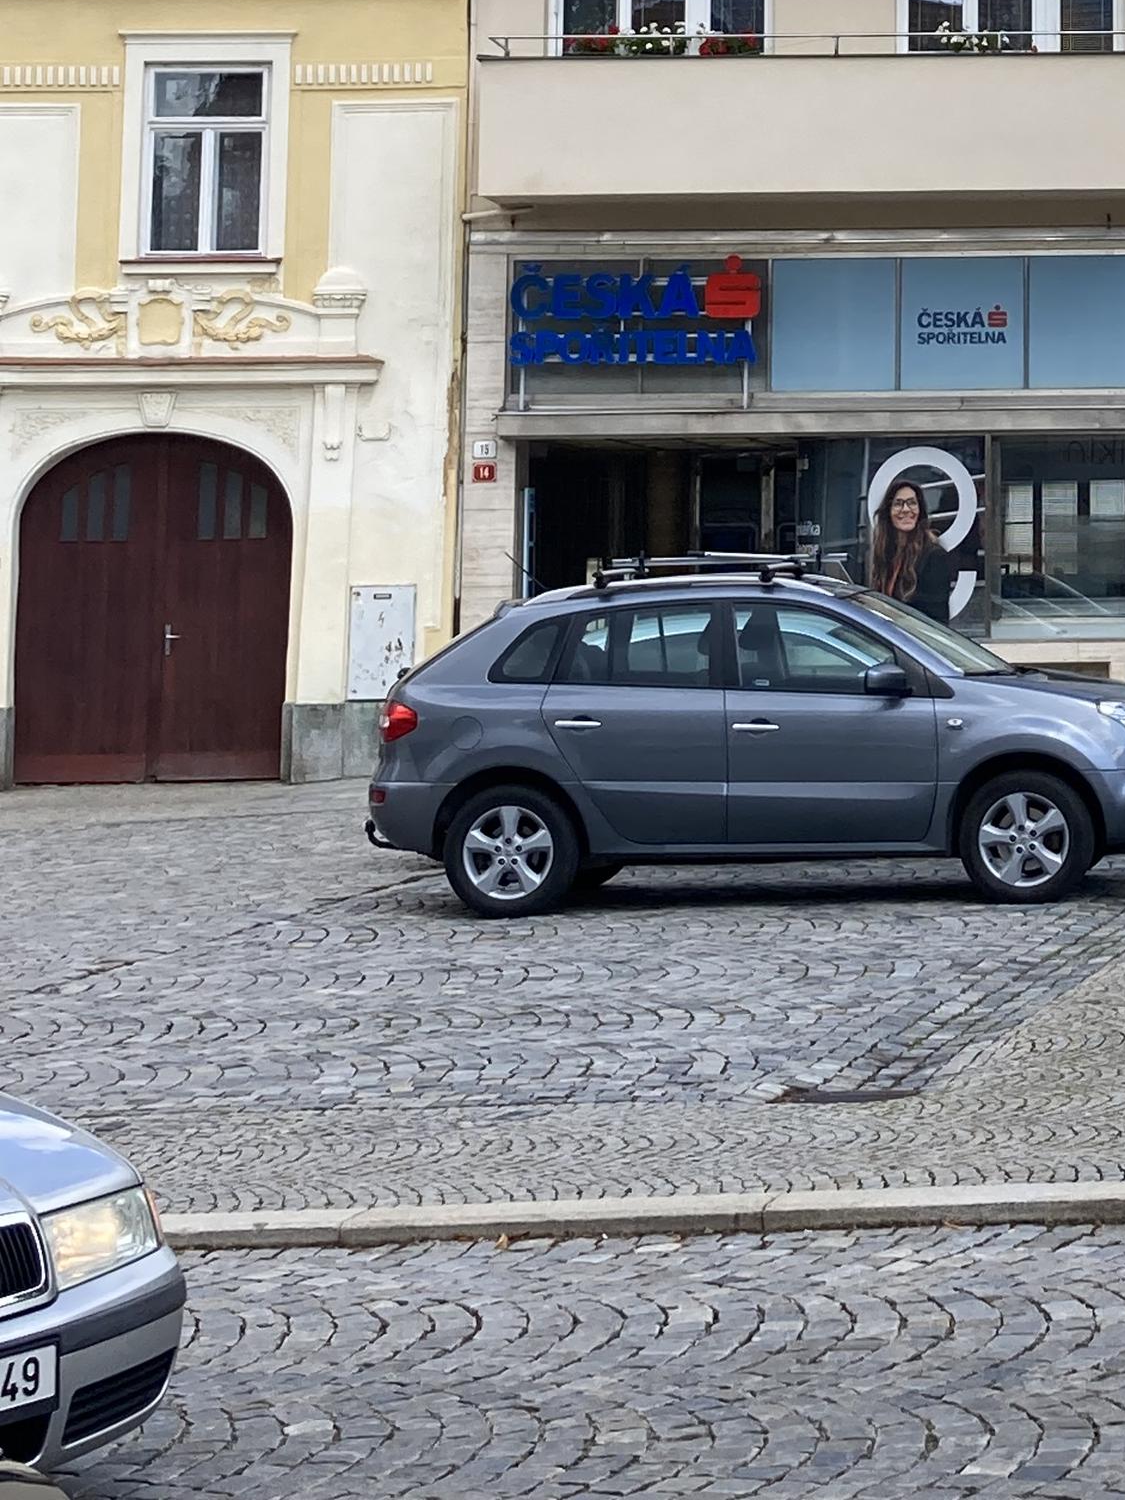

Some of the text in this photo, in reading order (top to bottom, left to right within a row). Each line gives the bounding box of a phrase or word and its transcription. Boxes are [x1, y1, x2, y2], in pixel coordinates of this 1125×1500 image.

[511, 263, 699, 318] ČESKÁ
[917, 307, 985, 328] ČESKÁ
[510, 325, 757, 365] SPOŘITELNA
[917, 329, 1007, 345] SPOŘITELNA
[480, 444, 490, 456] 15
[479, 466, 490, 479] 14
